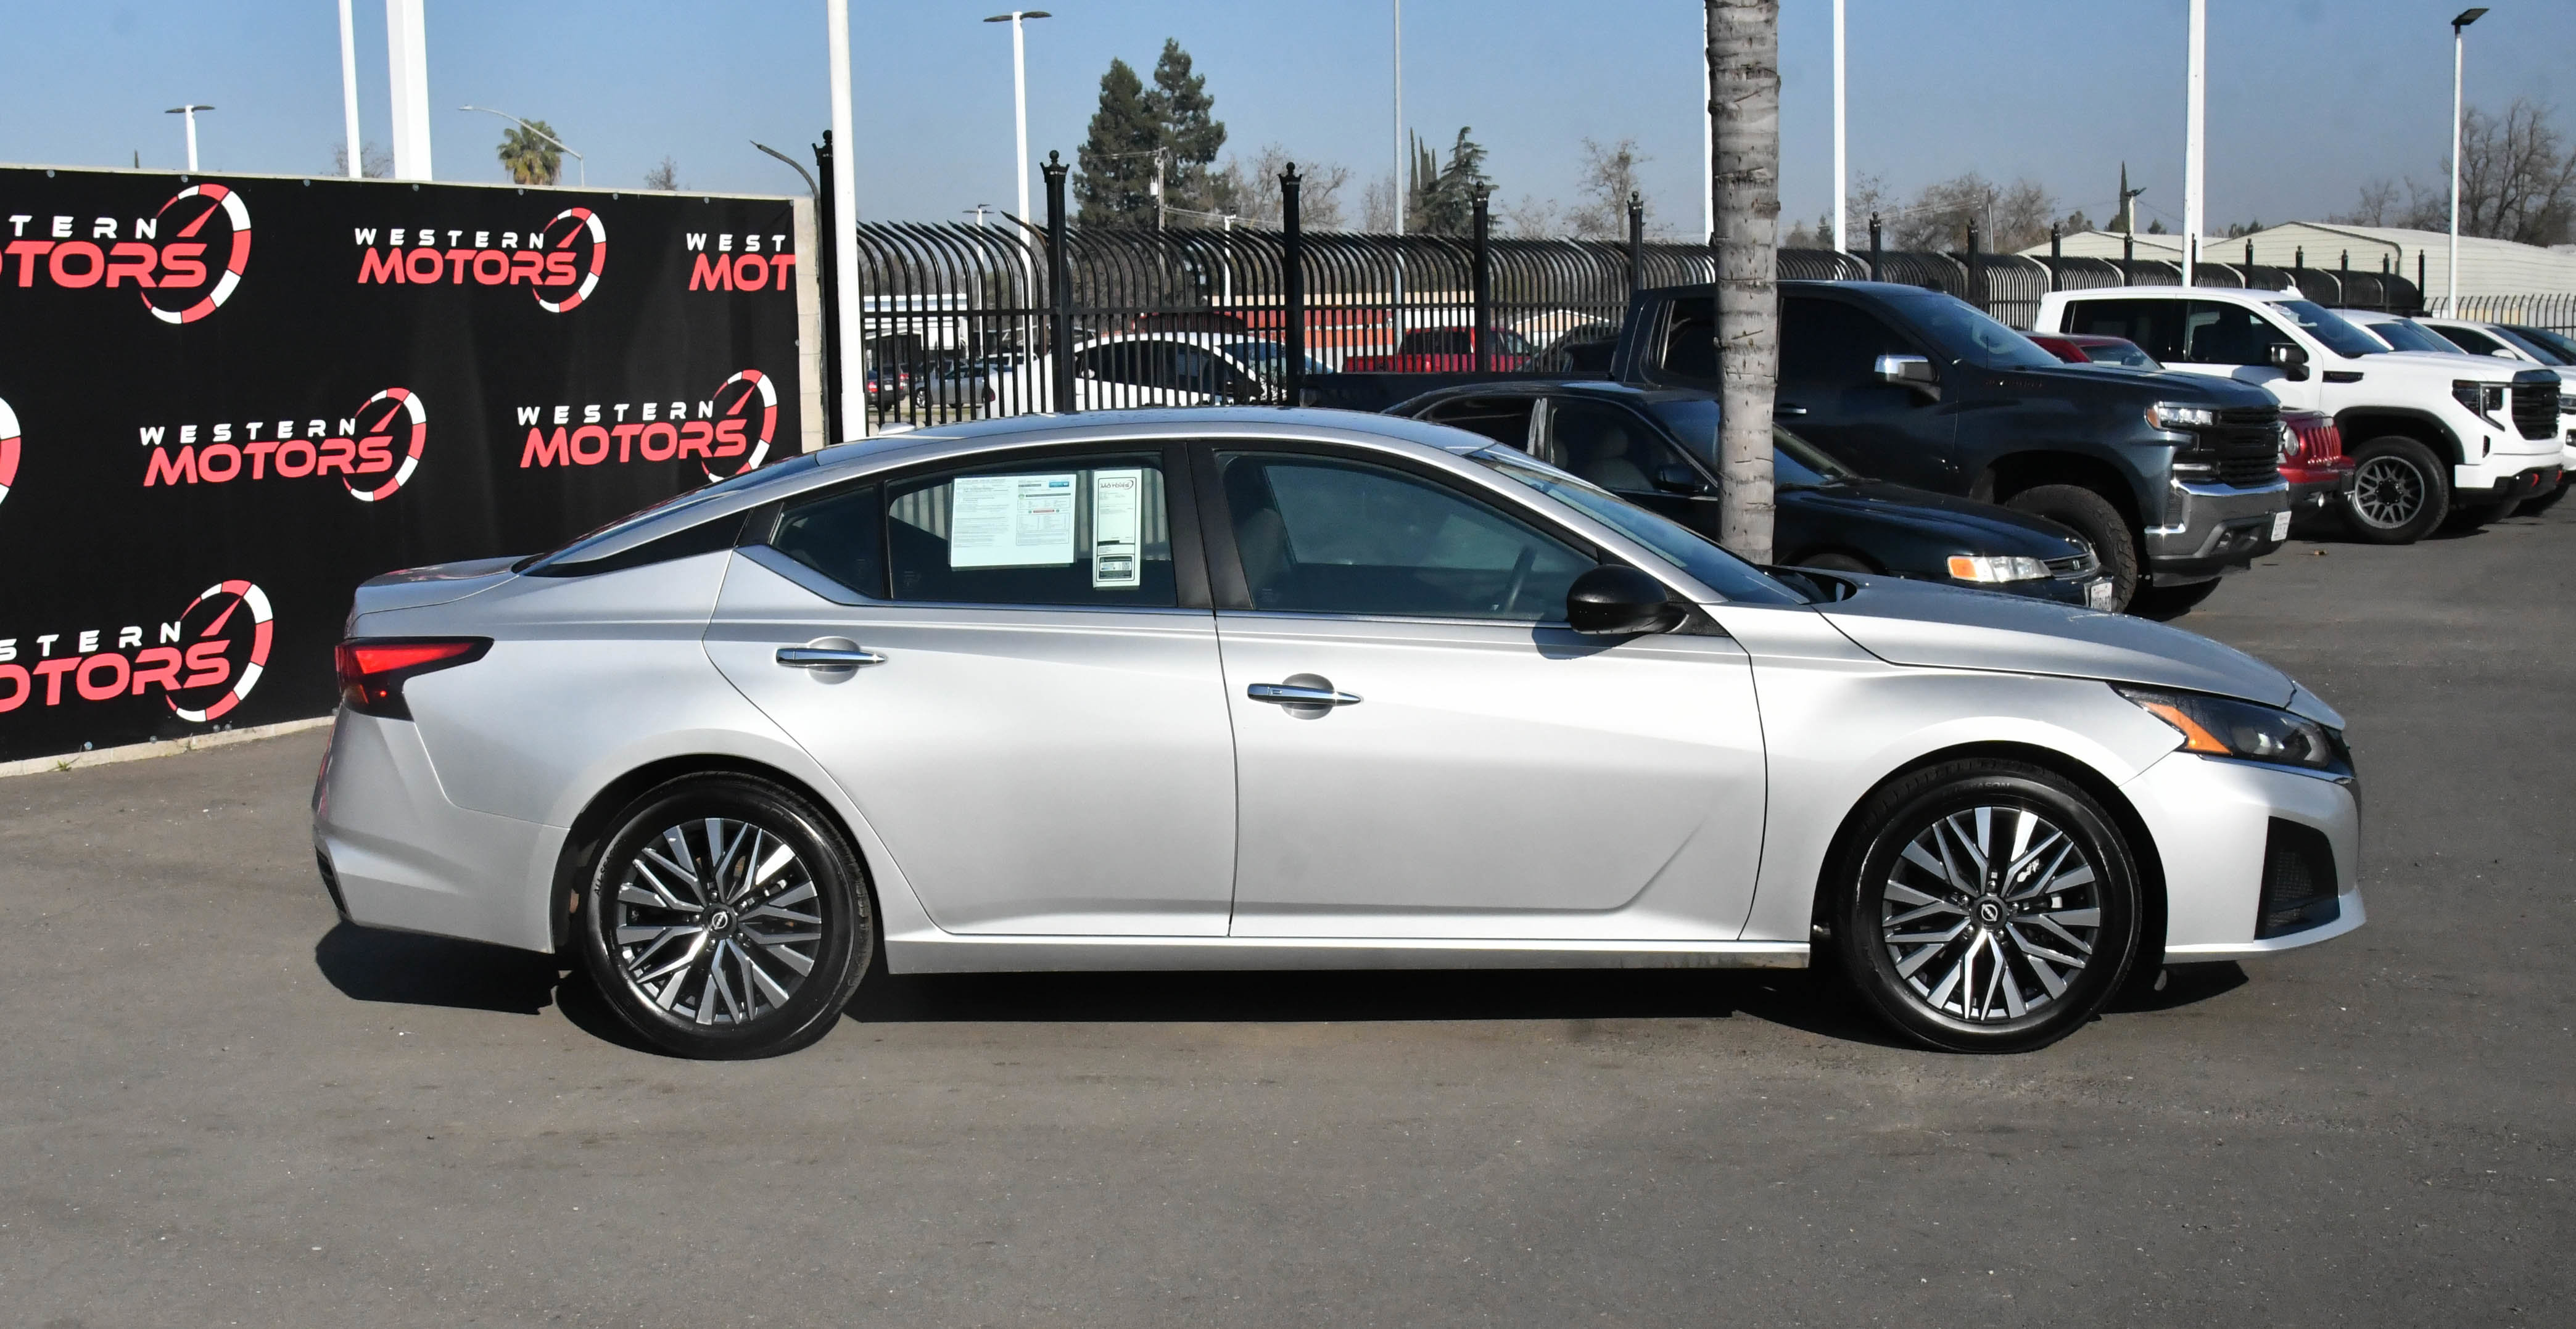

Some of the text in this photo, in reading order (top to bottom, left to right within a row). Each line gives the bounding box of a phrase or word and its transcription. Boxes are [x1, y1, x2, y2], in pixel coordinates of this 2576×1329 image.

[9, 215, 157, 239] TERN
[355, 228, 544, 250] WESTERN
[686, 232, 786, 252] WEST
[0, 240, 208, 289] TORS
[358, 247, 577, 287] MOTORS
[688, 252, 796, 292] MOT
[139, 418, 356, 446] WESTERN
[517, 400, 714, 426] WESTERN
[143, 435, 394, 487] MOTORS
[520, 419, 747, 469] MOTORS
[0, 621, 181, 662] STERN
